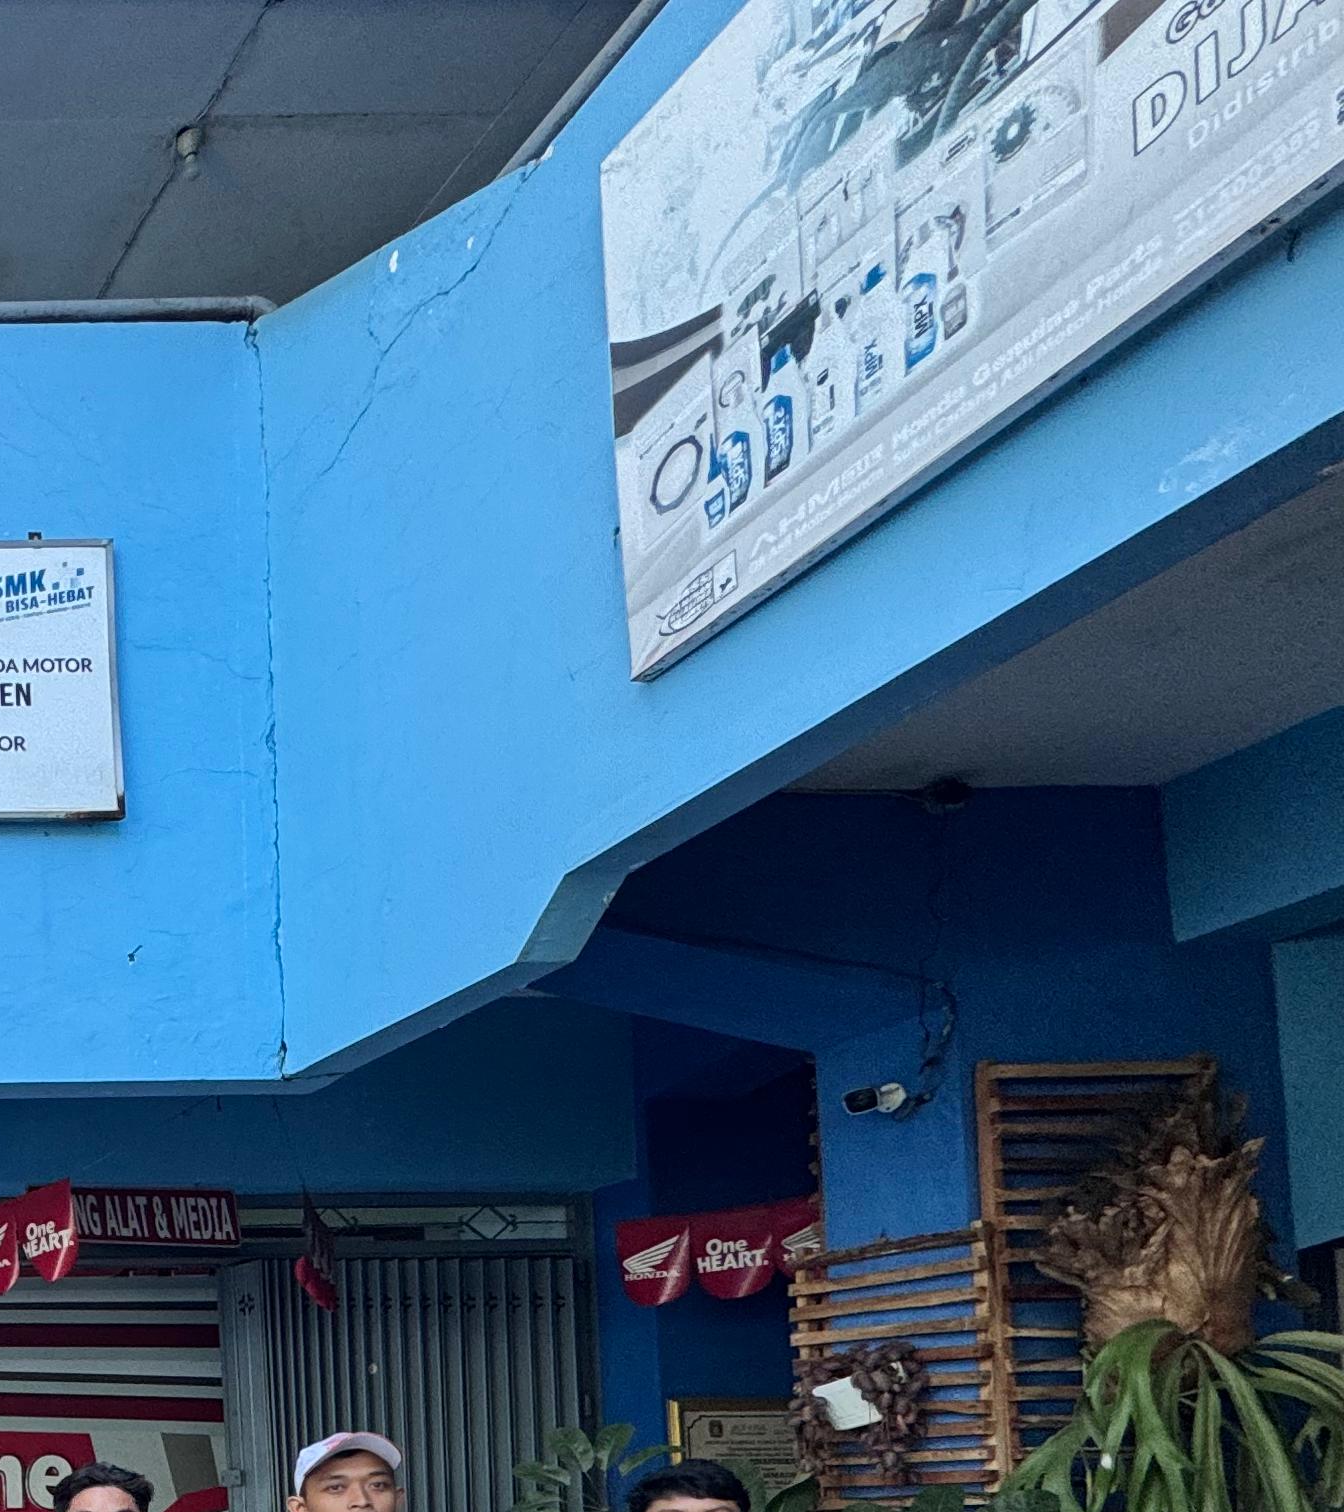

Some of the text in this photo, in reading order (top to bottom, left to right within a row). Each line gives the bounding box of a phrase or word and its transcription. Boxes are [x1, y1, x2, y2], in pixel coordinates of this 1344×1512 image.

[5, 586, 95, 613] BISA-HEBAT
[23, 658, 93, 673] MOTOR
[105, 1194, 149, 1238] ALAT
[153, 1196, 170, 1239] &
[171, 1196, 236, 1241] MEDIA
[26, 1221, 55, 1240] One
[705, 1238, 748, 1256] One
[624, 1269, 681, 1282] HONDA
